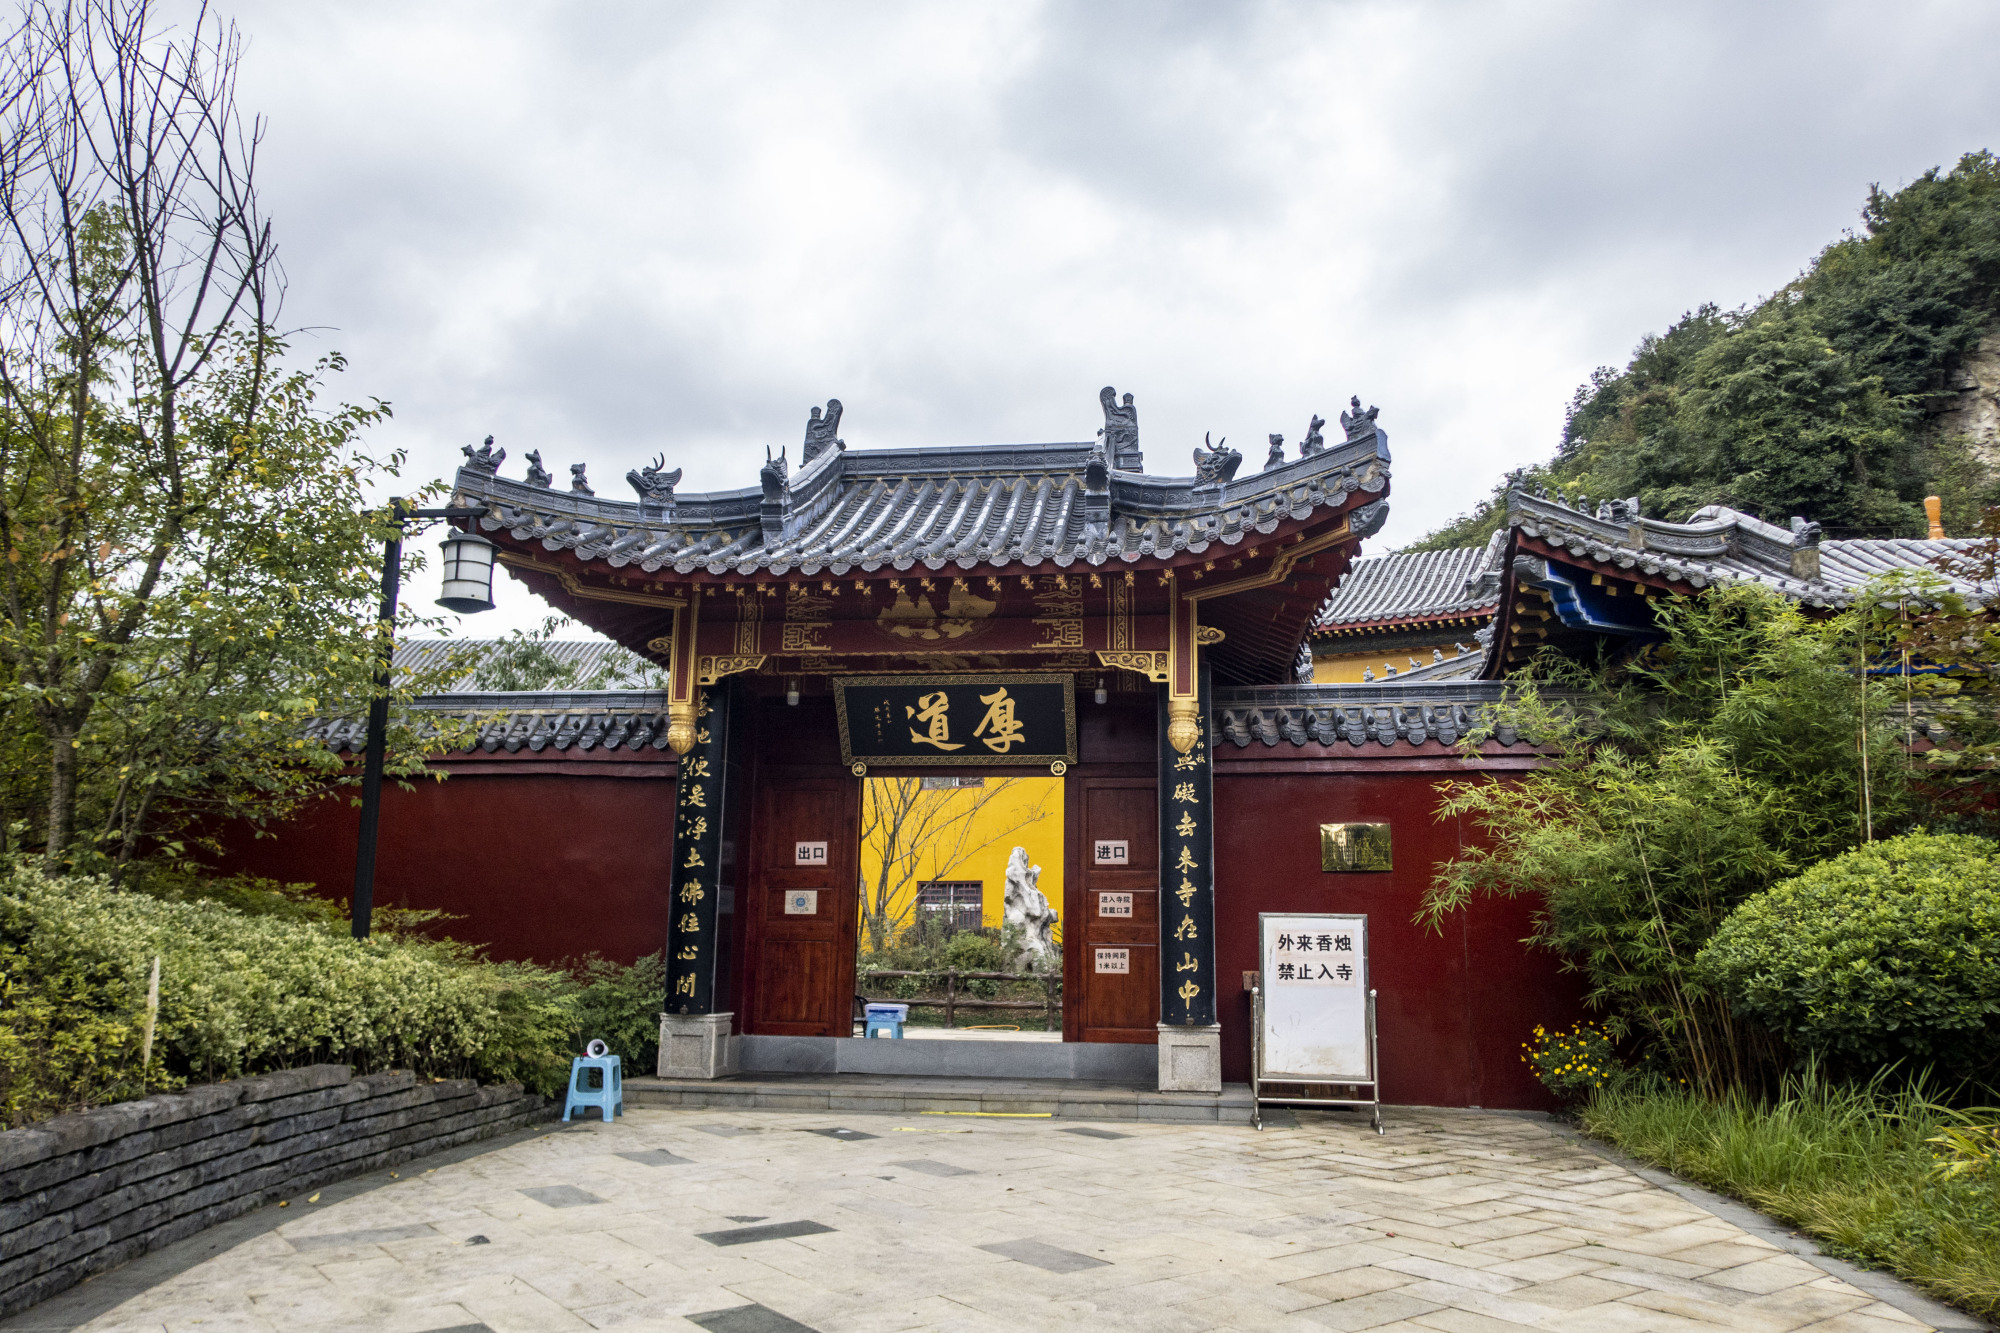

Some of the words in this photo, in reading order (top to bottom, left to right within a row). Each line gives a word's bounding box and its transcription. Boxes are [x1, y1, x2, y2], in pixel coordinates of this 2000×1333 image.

[798, 846, 824, 860] 出口
[1097, 846, 1125, 859] 进口
[1101, 896, 1131, 904] 进入寺院
[1278, 934, 1352, 951] 外来香烛
[1097, 952, 1127, 960] 保持间距
[1099, 962, 1126, 970] 1米以上
[1278, 963, 1353, 981] 禁止入寺
